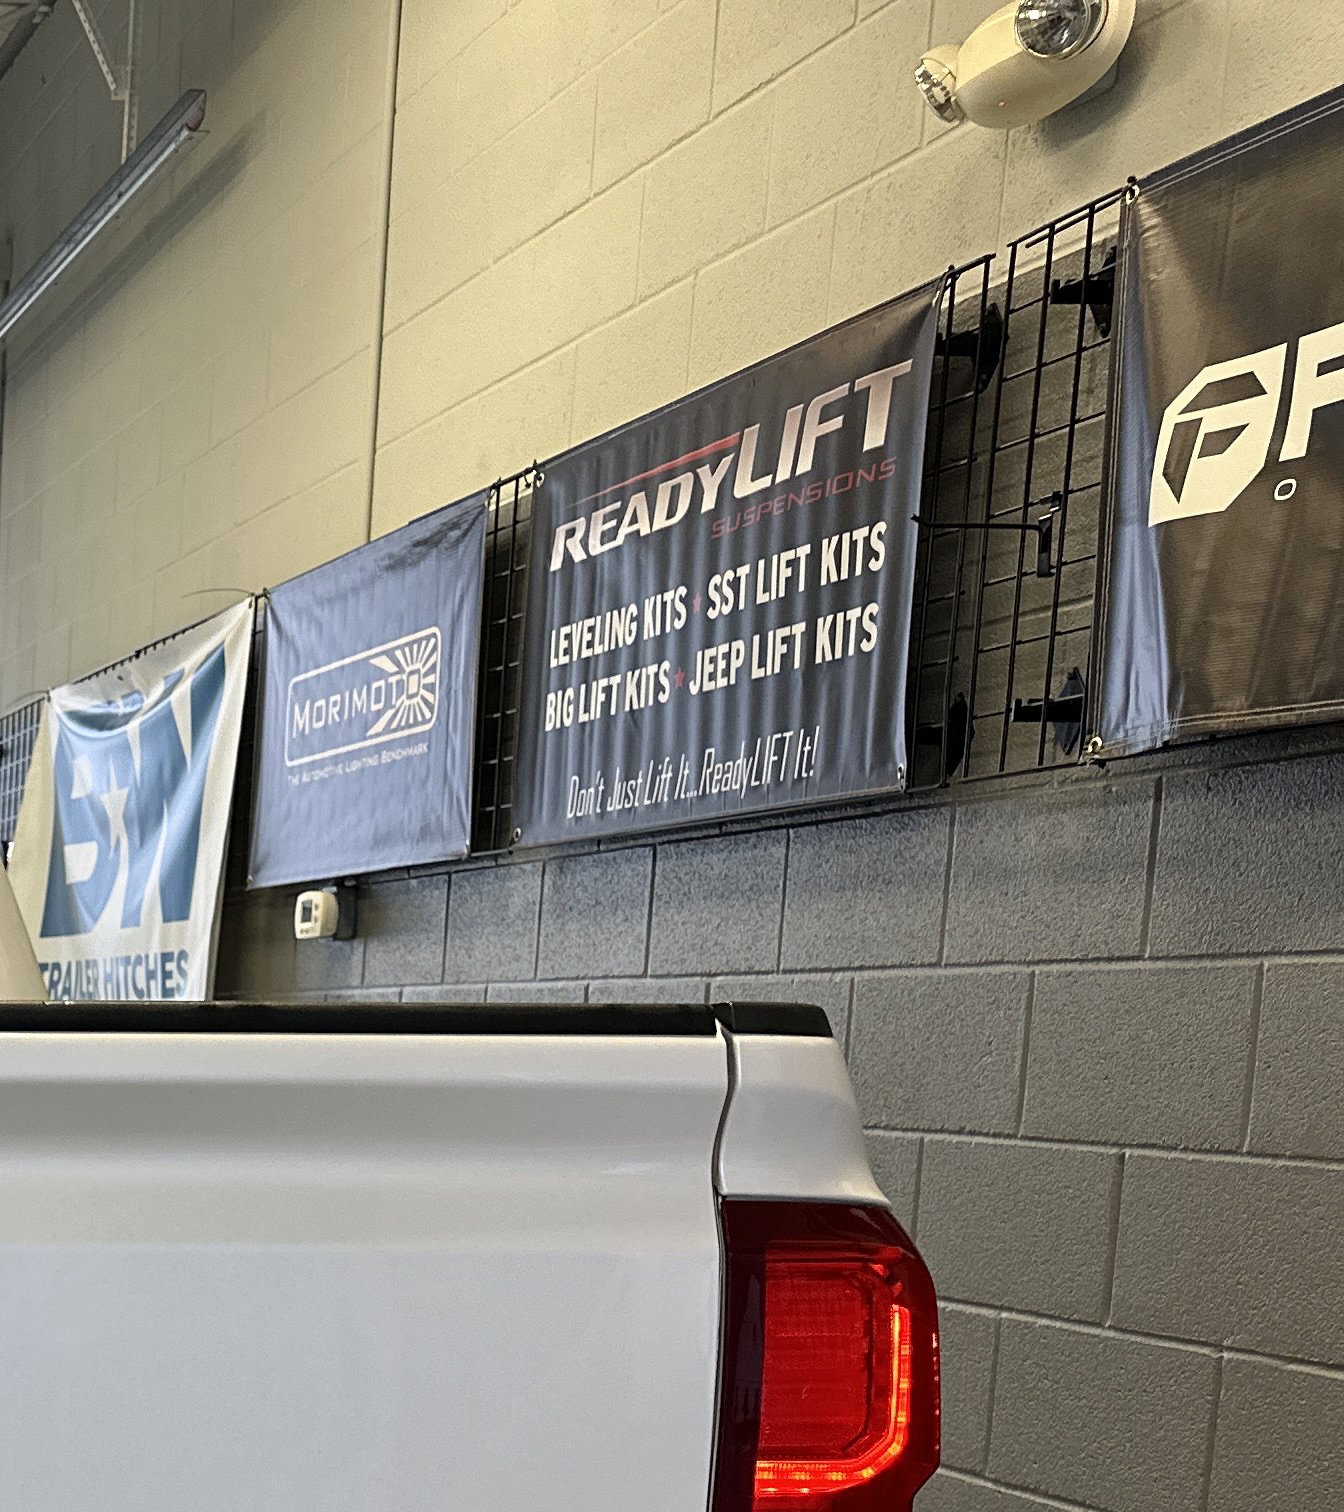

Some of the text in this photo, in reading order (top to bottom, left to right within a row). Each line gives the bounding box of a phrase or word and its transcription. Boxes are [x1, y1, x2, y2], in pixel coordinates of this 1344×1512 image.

[550, 358, 913, 572] READYLIFT
[711, 456, 898, 540] SUSPENSIONS
[550, 521, 887, 668] LEVELING KITS SST LIFT KITS
[290, 666, 423, 739] MORIMOTO
[545, 602, 879, 732] BIG LIFT KITS JEEP LIFT KITS
[567, 774, 605, 819] Don't
[607, 765, 643, 812] Just
[645, 756, 673, 804] Lift
[794, 725, 820, 780] It!
[103, 949, 189, 1000] HITCHES
